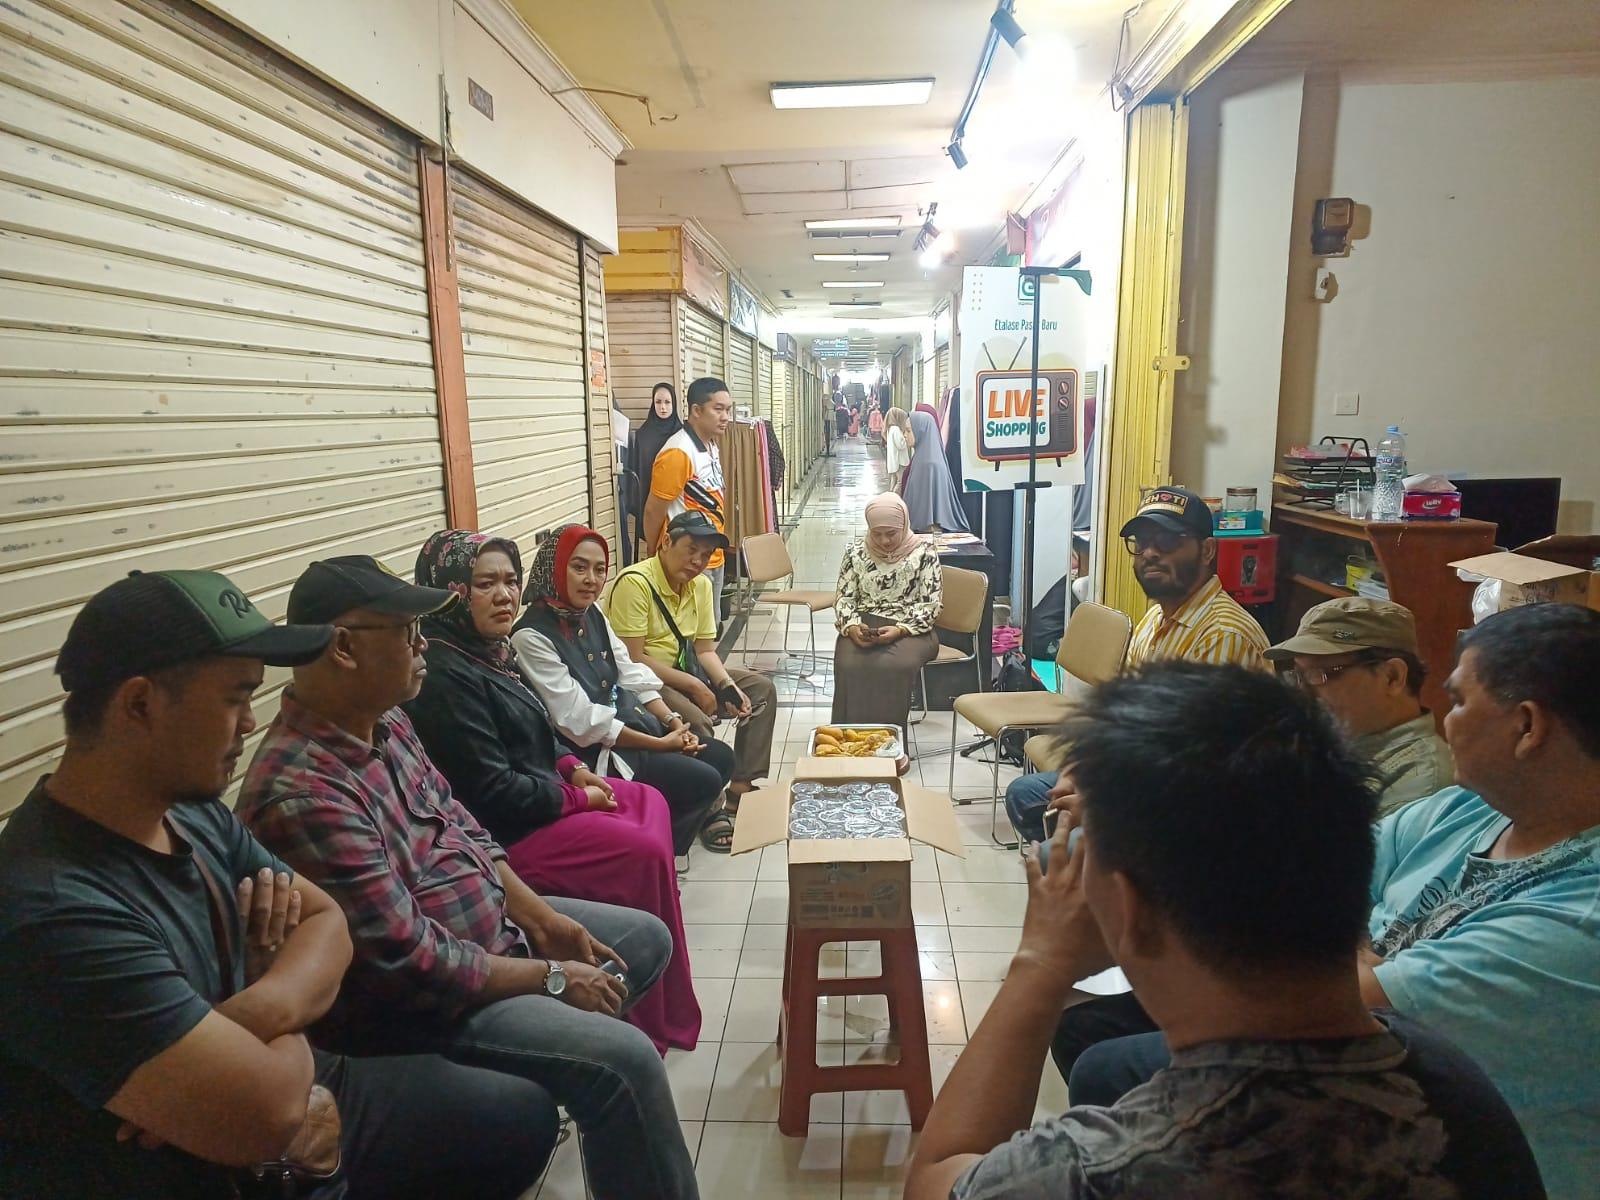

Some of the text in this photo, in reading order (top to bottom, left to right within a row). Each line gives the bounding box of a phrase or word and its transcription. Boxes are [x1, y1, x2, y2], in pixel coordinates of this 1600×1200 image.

[995, 319, 1019, 331] Etalase
[1041, 319, 1058, 331] Baru
[988, 389, 1046, 418] LIVE
